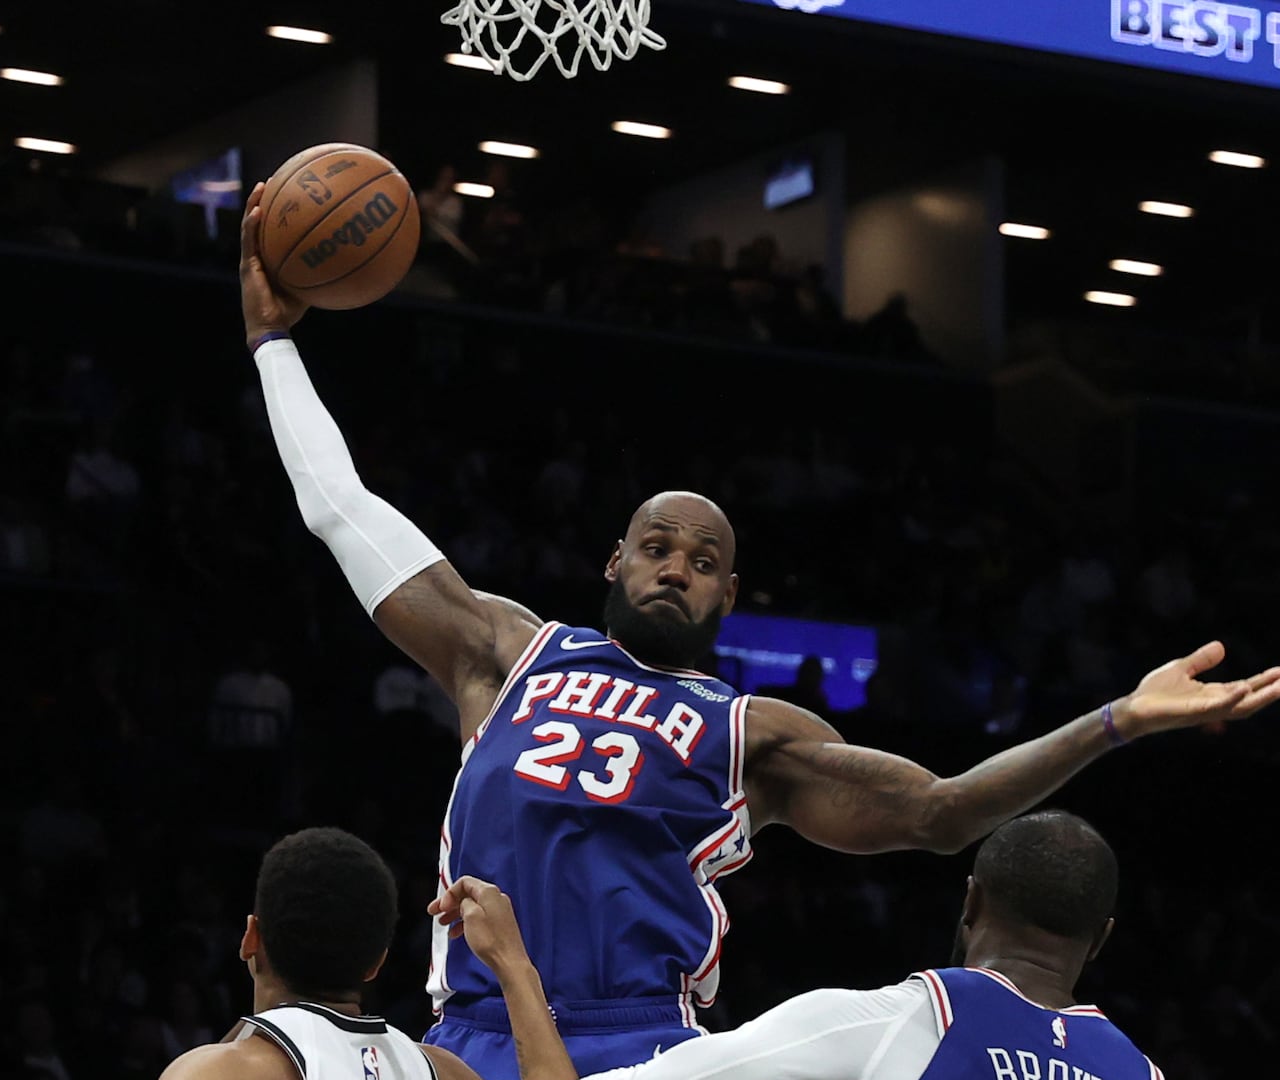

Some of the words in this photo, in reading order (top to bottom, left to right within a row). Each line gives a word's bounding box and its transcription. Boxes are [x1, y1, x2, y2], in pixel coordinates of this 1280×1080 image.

[1111, 0, 1260, 61] BEST
[301, 192, 397, 269] Wilson
[512, 671, 706, 767] PHILA
[513, 721, 645, 804] 23
